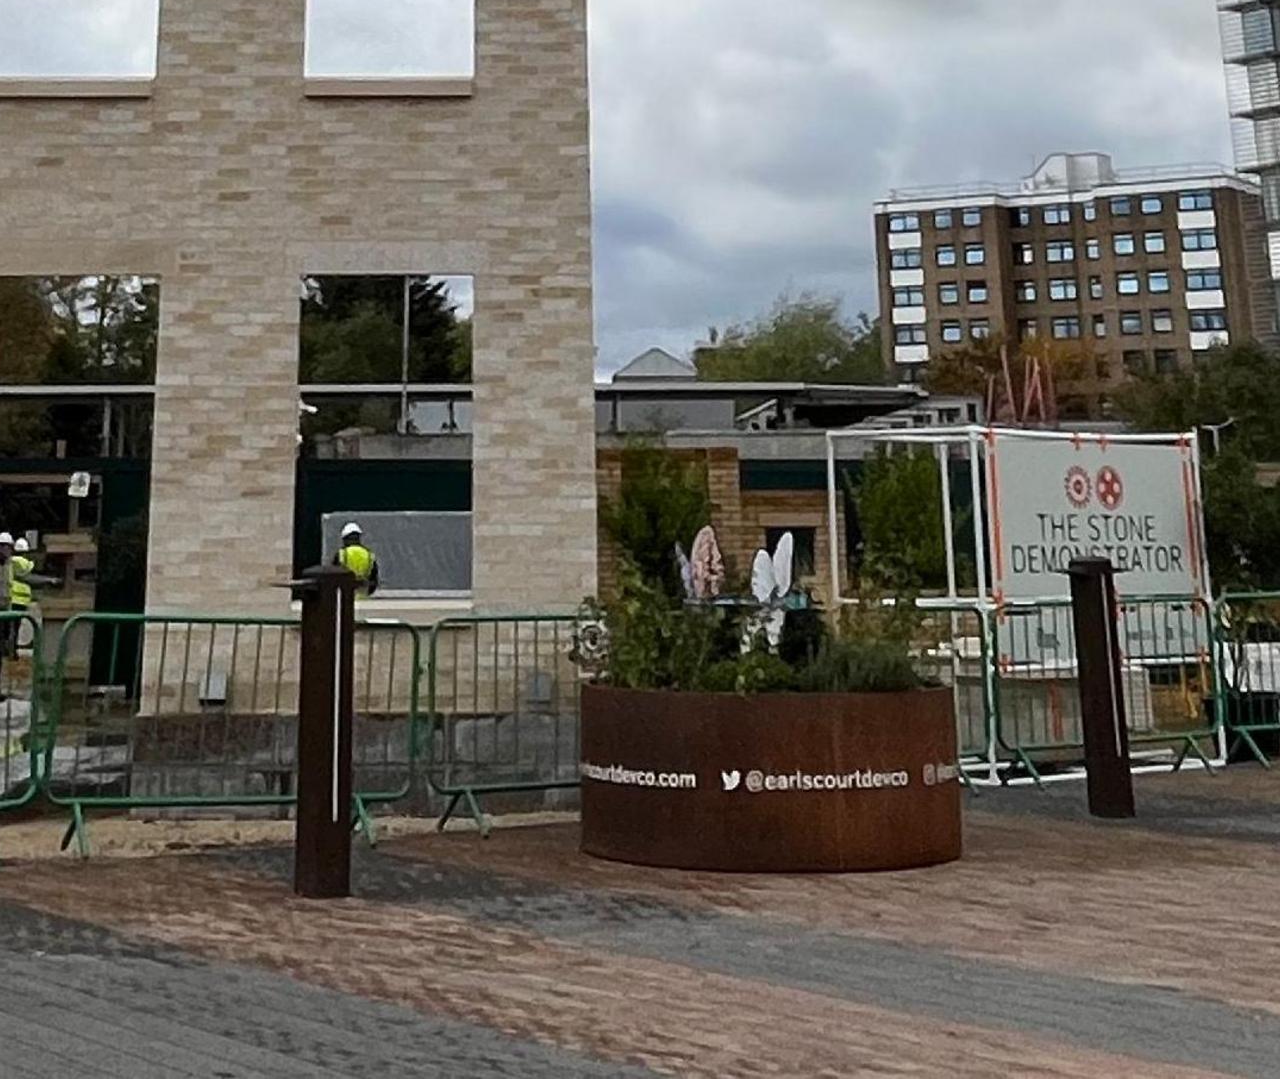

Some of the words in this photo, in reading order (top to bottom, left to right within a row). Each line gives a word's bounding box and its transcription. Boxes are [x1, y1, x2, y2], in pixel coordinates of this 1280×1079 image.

[1037, 513, 1079, 541] THE
[1087, 513, 1156, 542] STONE
[745, 770, 908, 792] @earlscourtdevco
